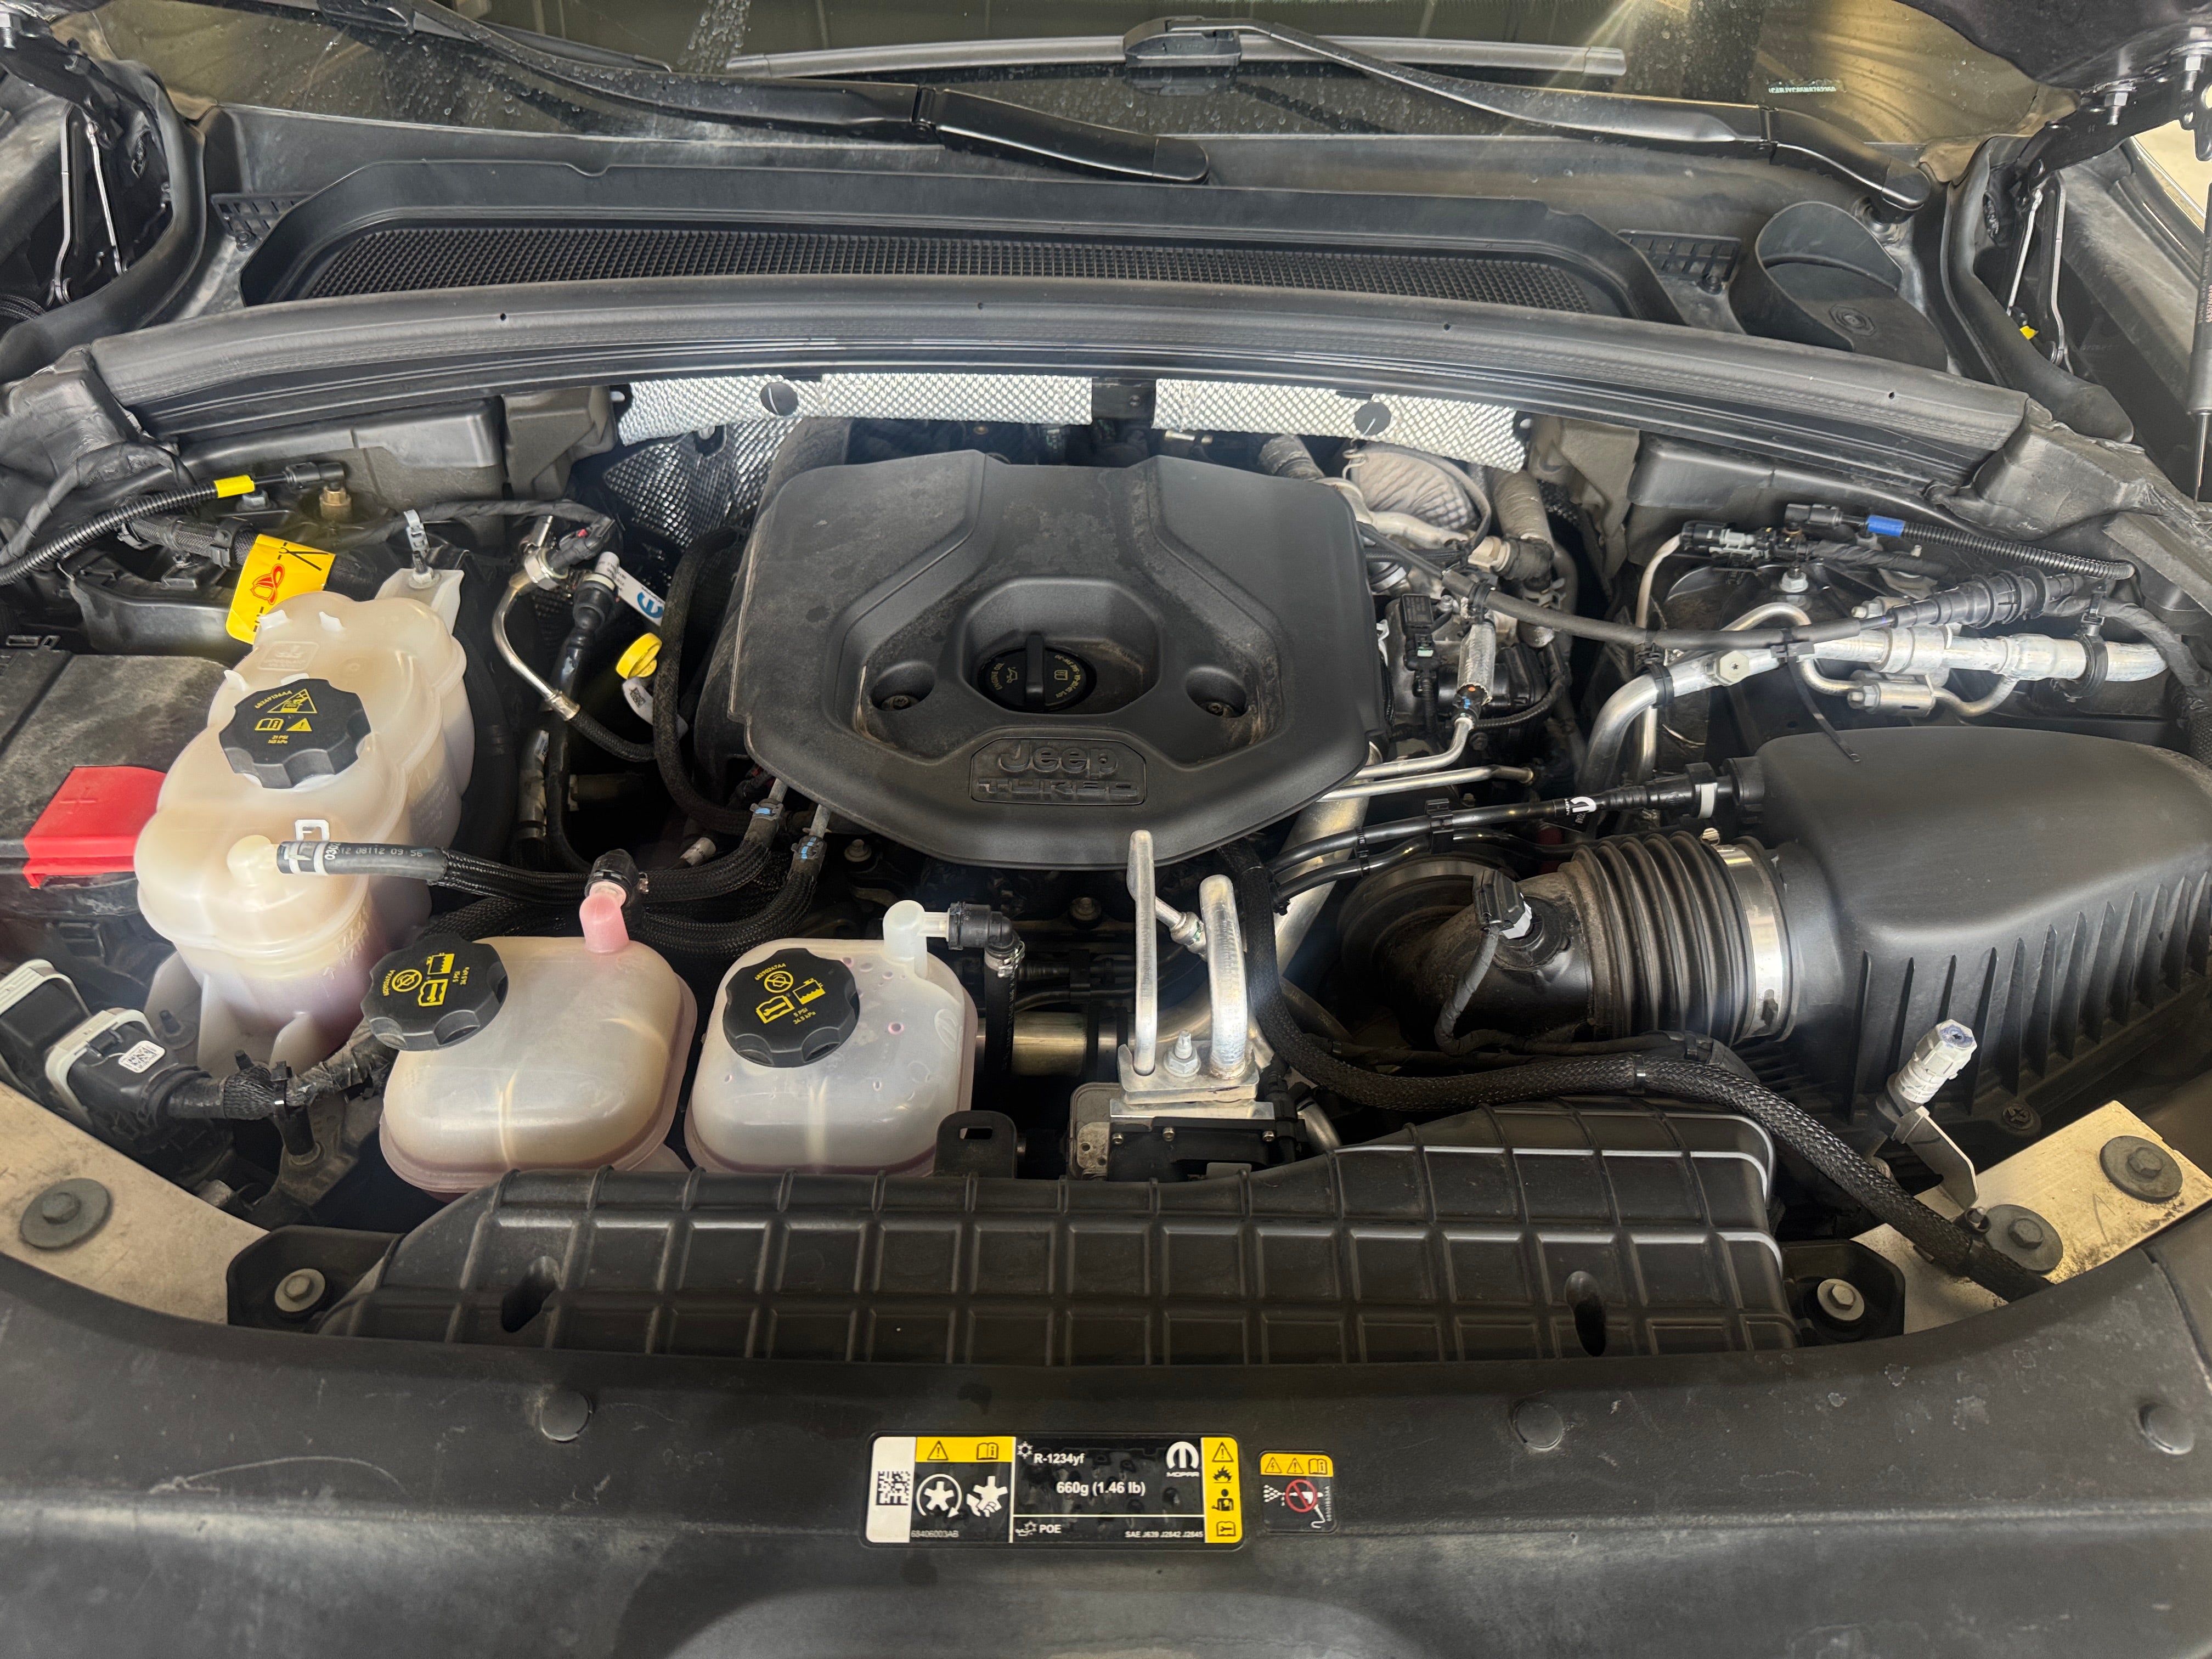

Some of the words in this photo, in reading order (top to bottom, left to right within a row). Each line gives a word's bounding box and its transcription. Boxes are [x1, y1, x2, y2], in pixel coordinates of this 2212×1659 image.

[995, 662, 1006, 671] OIL
[991, 670, 1003, 691] ENGINE
[998, 740, 1119, 778] Jeep
[798, 1007, 809, 1016] PSI
[804, 1011, 817, 1020] kPa
[1033, 1453, 1085, 1466] R-1234yf
[1056, 1481, 1089, 1496] 660g
[1092, 1481, 1125, 1496] (1.46
[1127, 1481, 1146, 1496] lb)
[1039, 1524, 1062, 1534] POE
